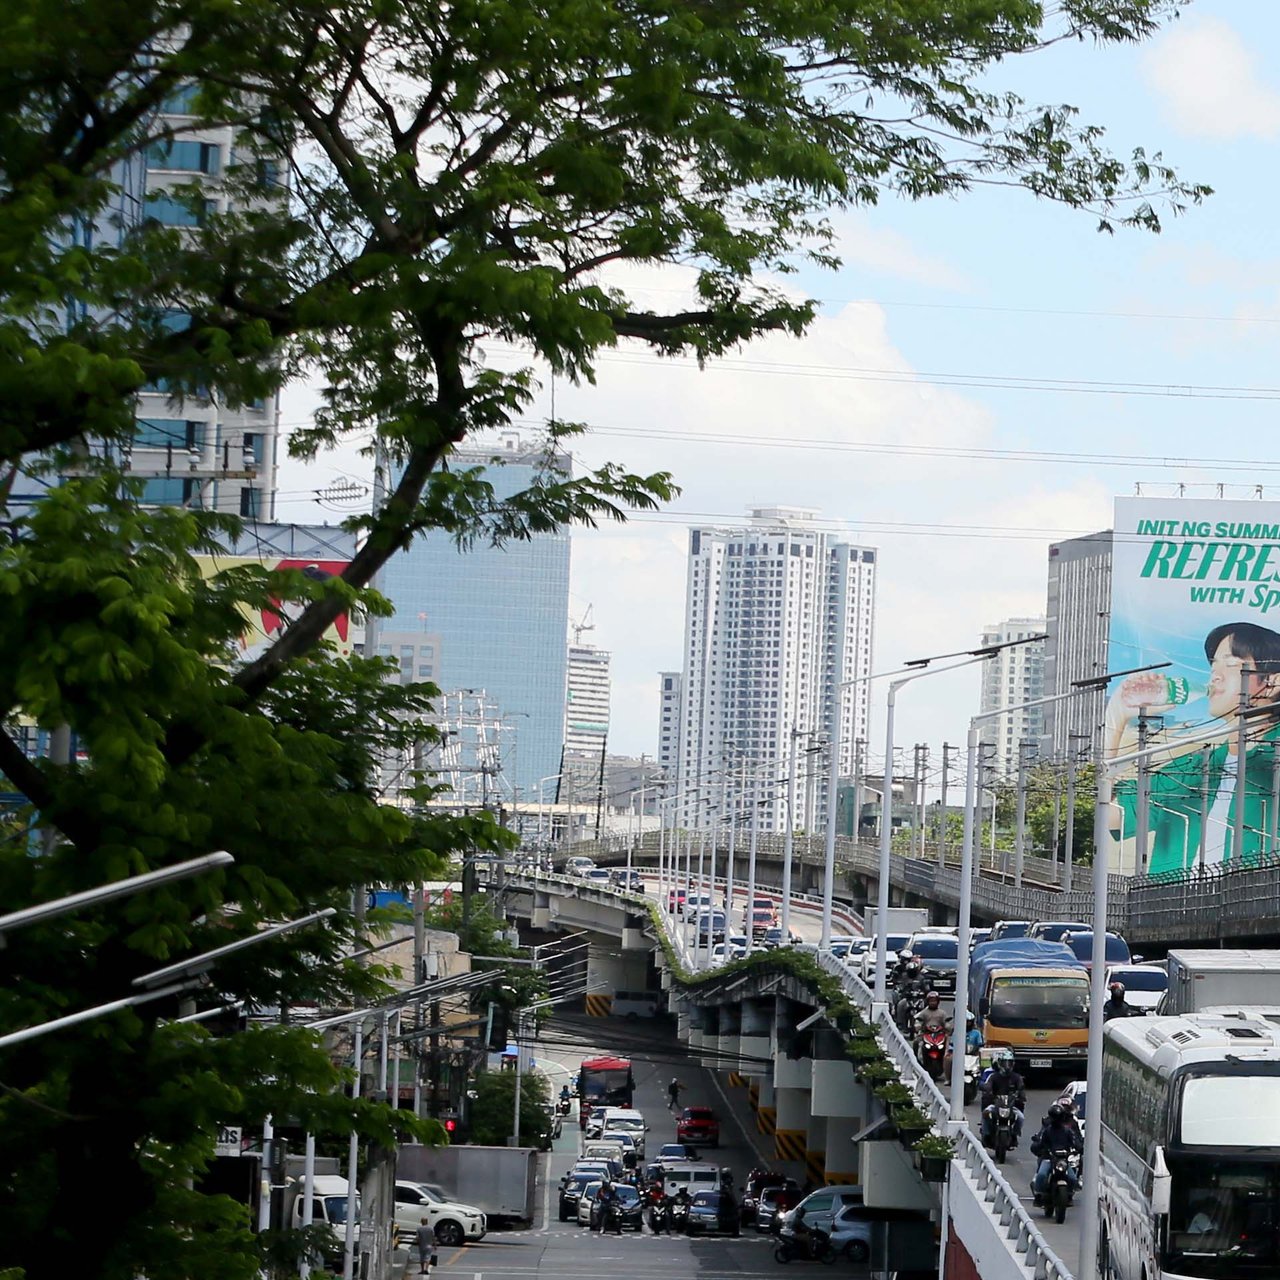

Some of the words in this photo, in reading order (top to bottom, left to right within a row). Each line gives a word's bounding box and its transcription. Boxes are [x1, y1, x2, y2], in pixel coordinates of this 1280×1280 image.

[1136, 519, 1180, 536] INIT
[1181, 521, 1212, 537] NG
[1190, 586, 1245, 604] WITH
